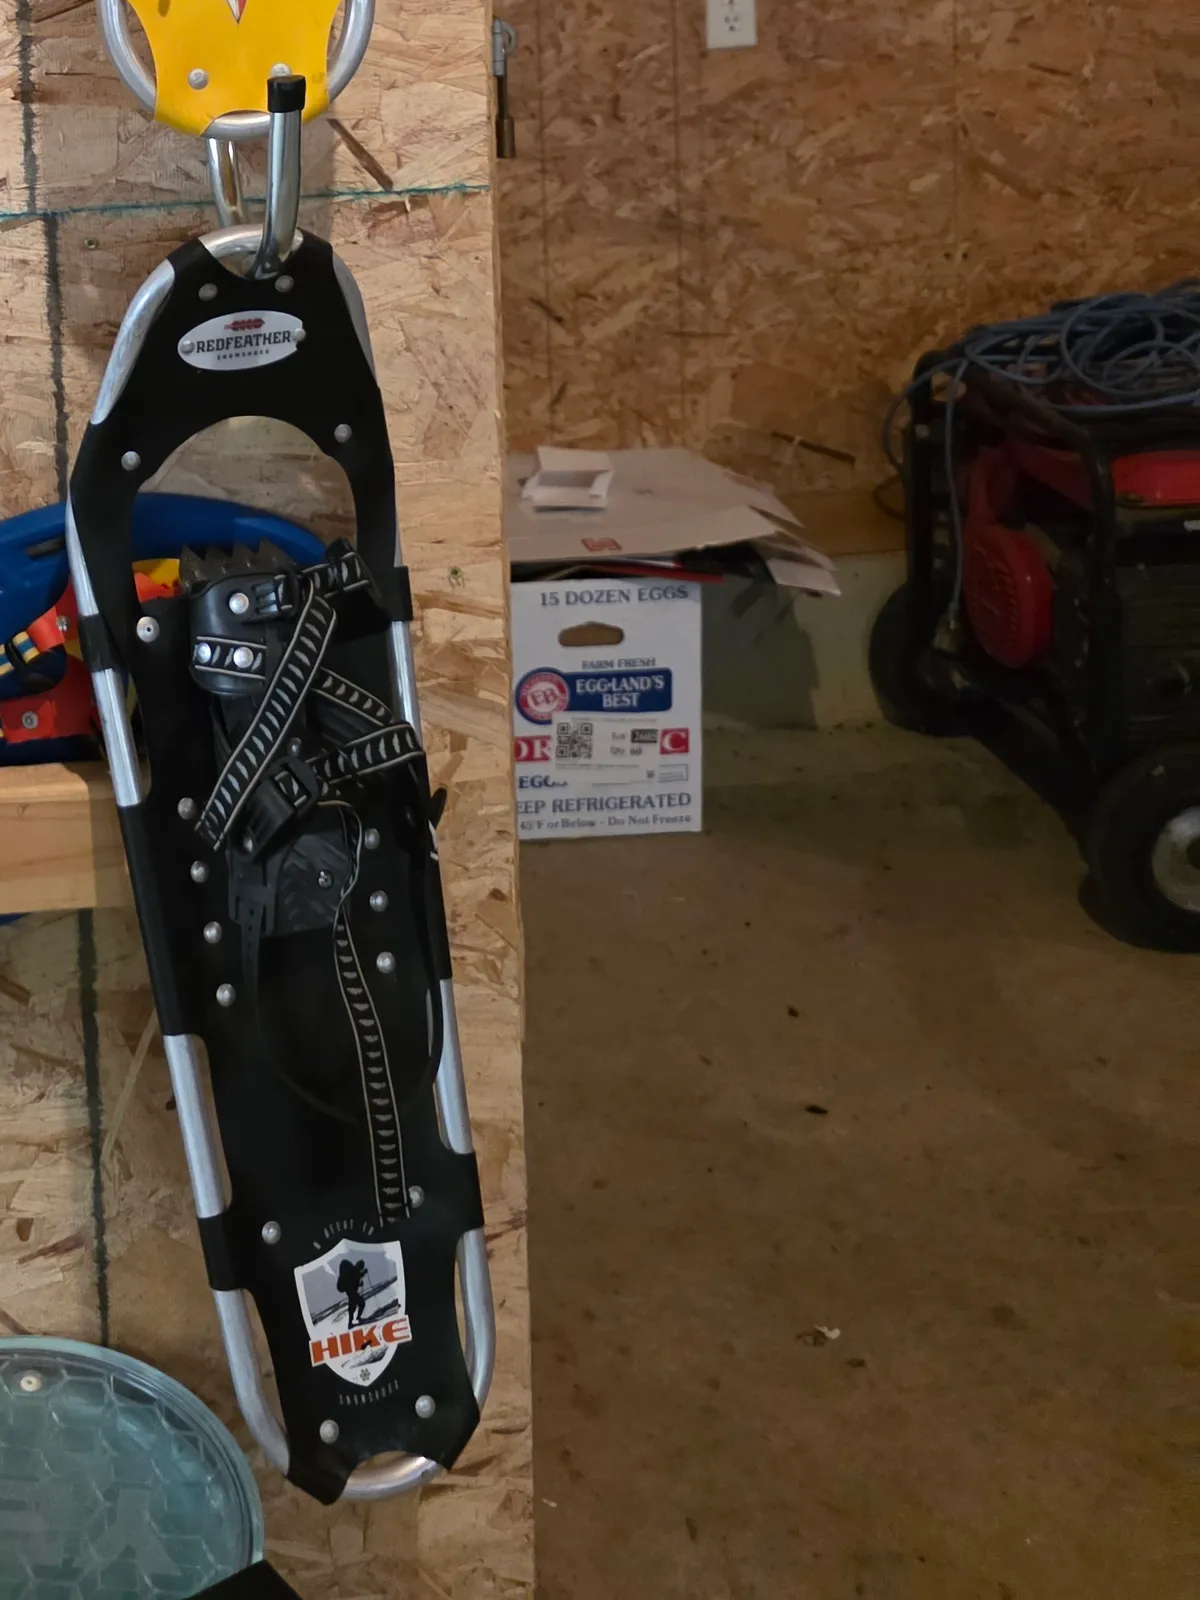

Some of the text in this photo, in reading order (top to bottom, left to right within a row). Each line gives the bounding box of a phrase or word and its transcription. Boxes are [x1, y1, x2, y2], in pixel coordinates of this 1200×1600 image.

[196, 330, 291, 353] REDFEATHER
[540, 584, 689, 606] 15 DOZEN EGGS
[582, 657, 656, 670] FARM FRESH
[602, 692, 640, 709] BEST
[517, 792, 692, 814] EEP REFRIGERATED
[311, 1317, 410, 1364] HIKE
